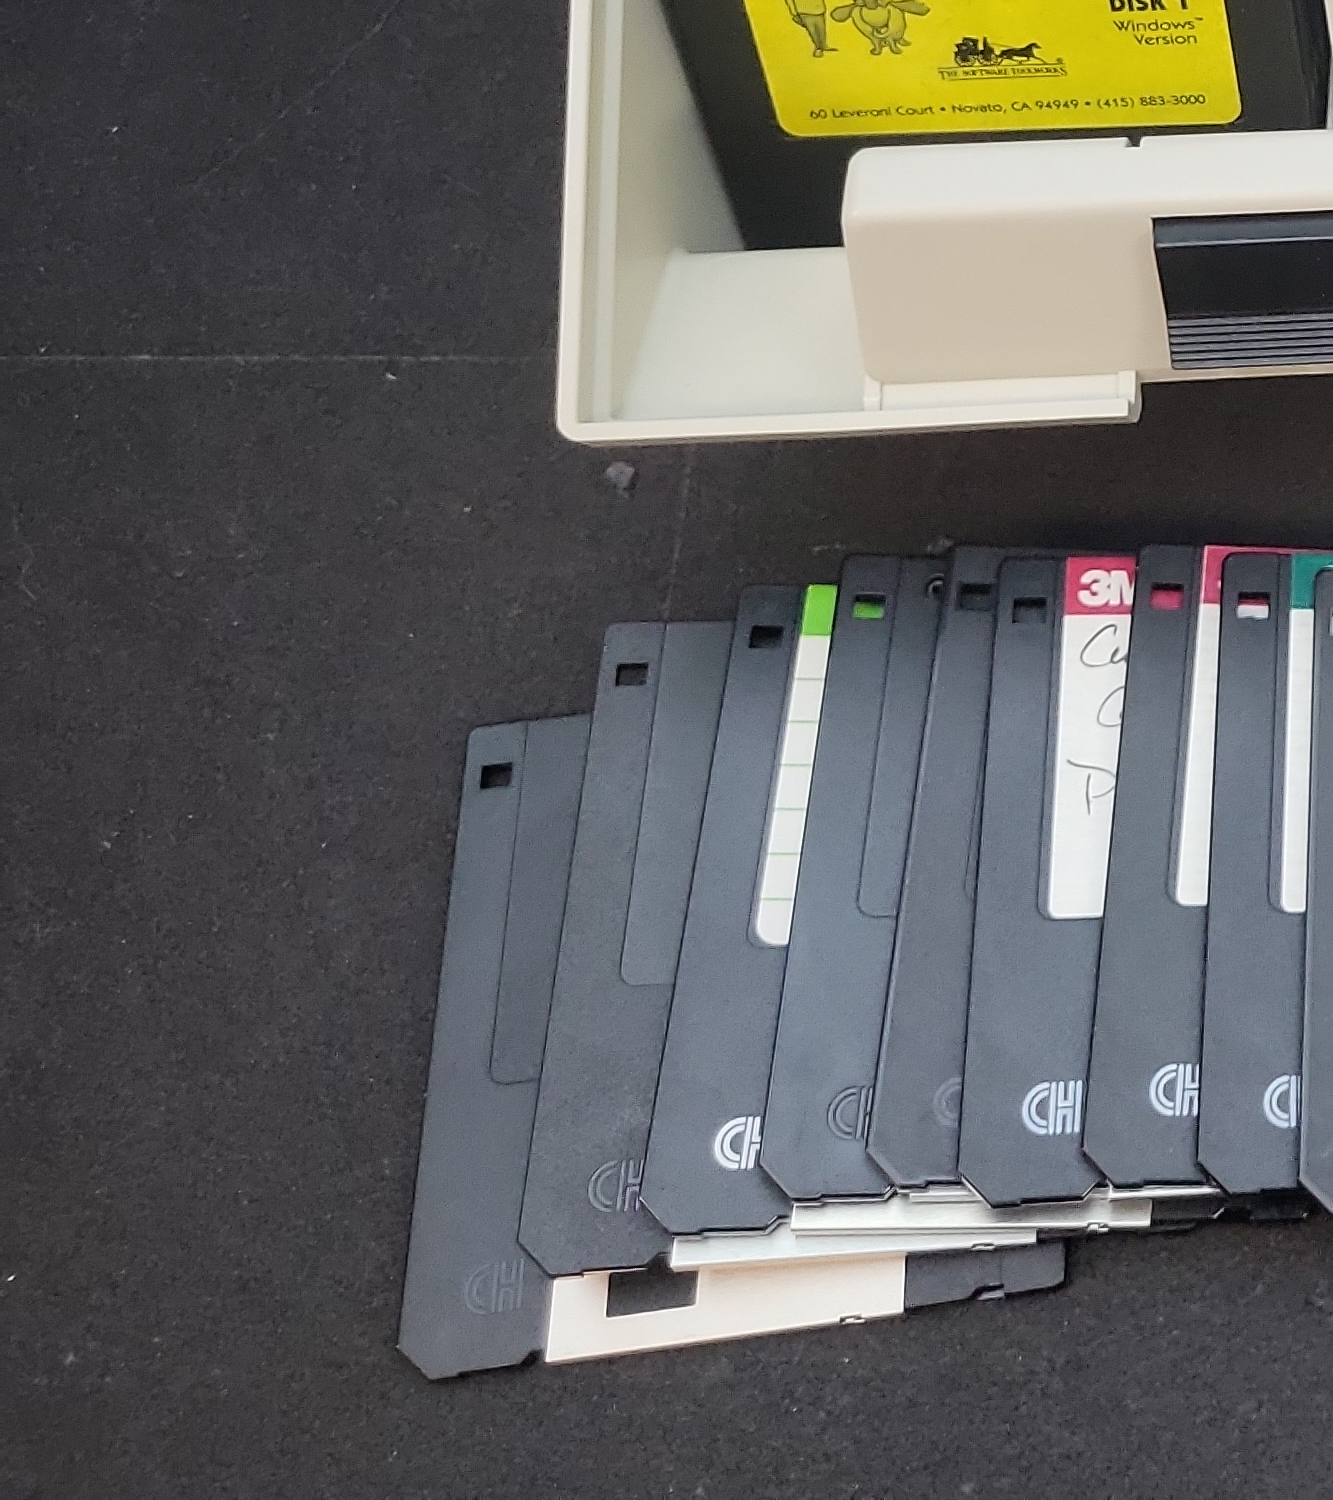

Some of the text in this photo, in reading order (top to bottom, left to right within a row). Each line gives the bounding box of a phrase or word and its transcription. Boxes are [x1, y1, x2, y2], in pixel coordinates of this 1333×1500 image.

[1112, 17, 1196, 34] Windows
[1133, 32, 1199, 47] Version
[810, 94, 1206, 119] 60 Leveroni Court Novato, CA 94949 (415) 883-3000
[1078, 570, 1135, 607] 3M
